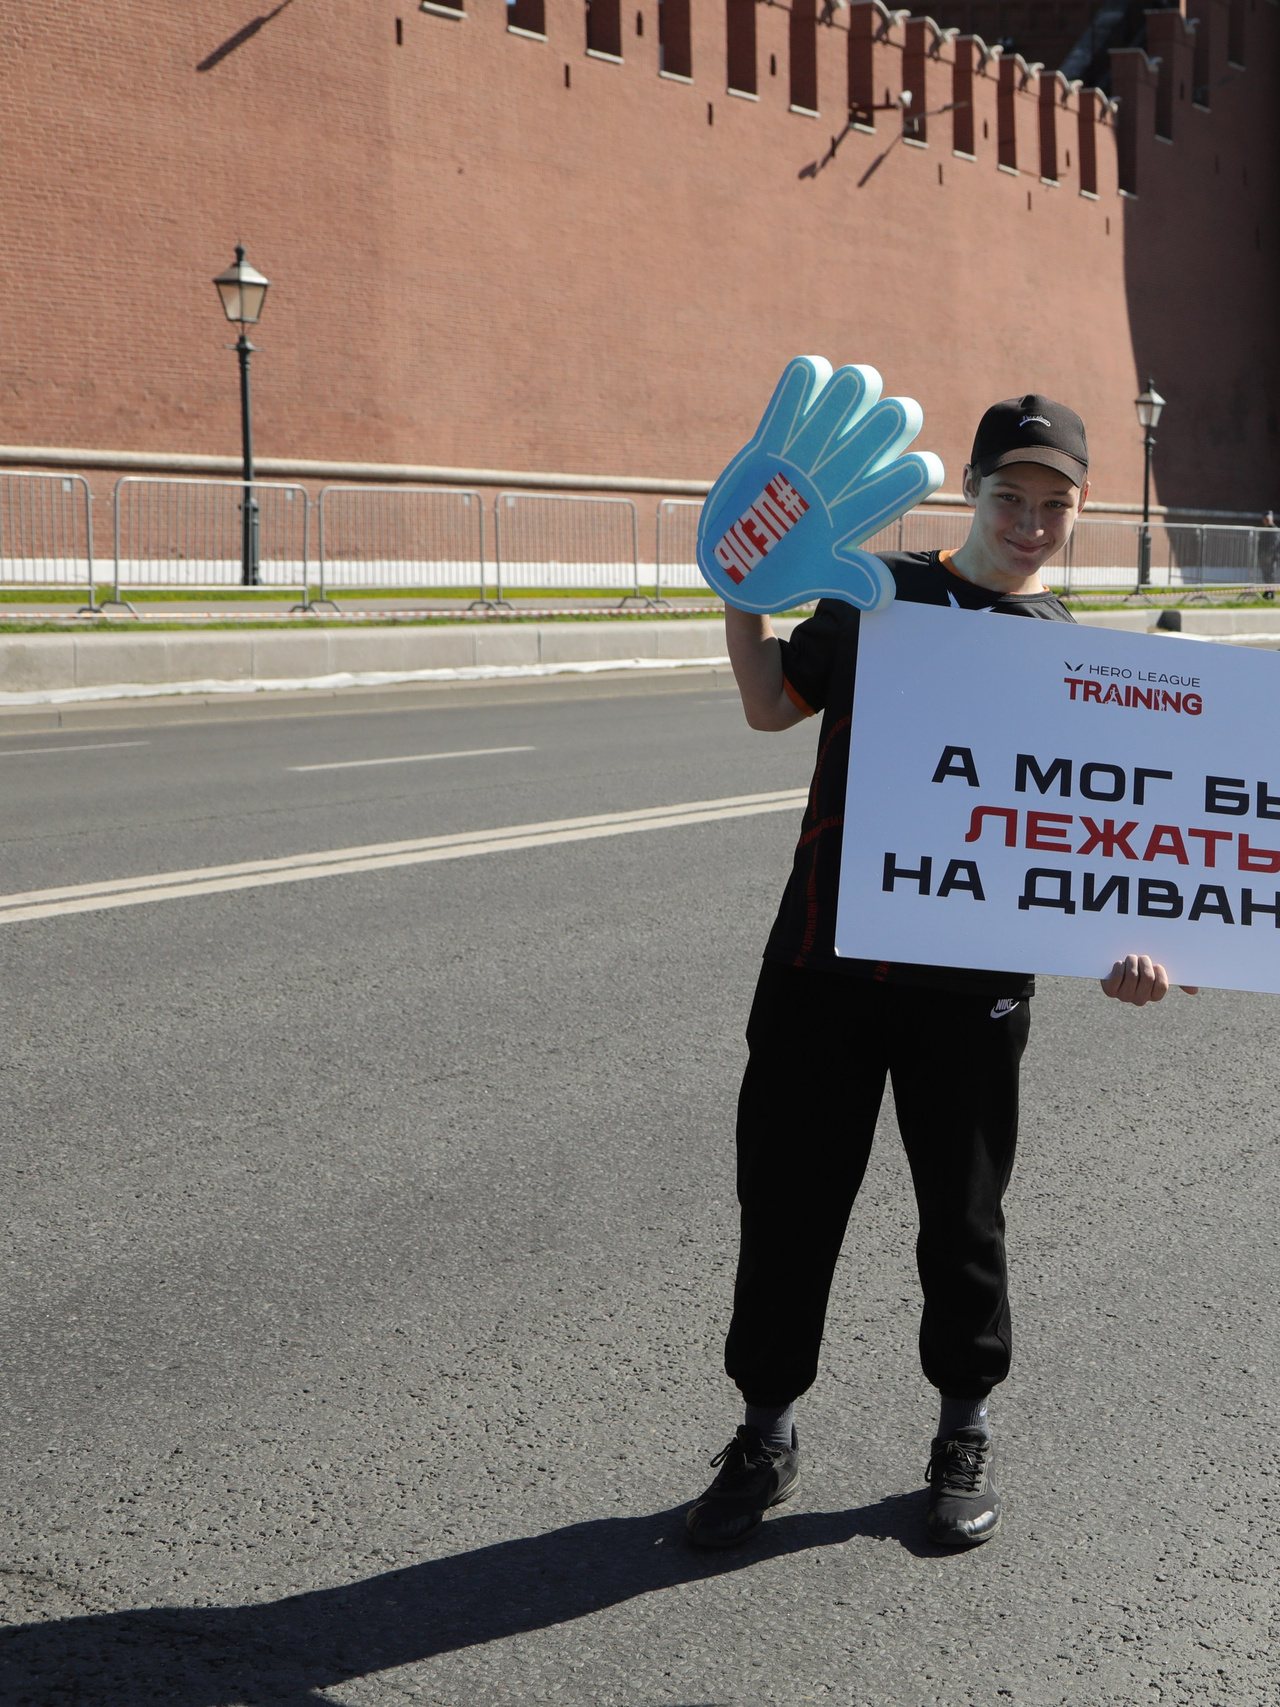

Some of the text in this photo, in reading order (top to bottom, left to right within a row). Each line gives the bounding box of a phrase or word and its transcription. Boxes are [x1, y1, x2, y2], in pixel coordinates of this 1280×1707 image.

[713, 472, 810, 585] #ЦЕЛЬ
[1063, 677, 1203, 716] TRAINING
[1089, 664, 1201, 688] HERO LEAGUE
[931, 745, 980, 788] А
[1014, 753, 1173, 806] МОГ
[881, 852, 986, 902] НА
[994, 998, 1014, 1011] NIKE
